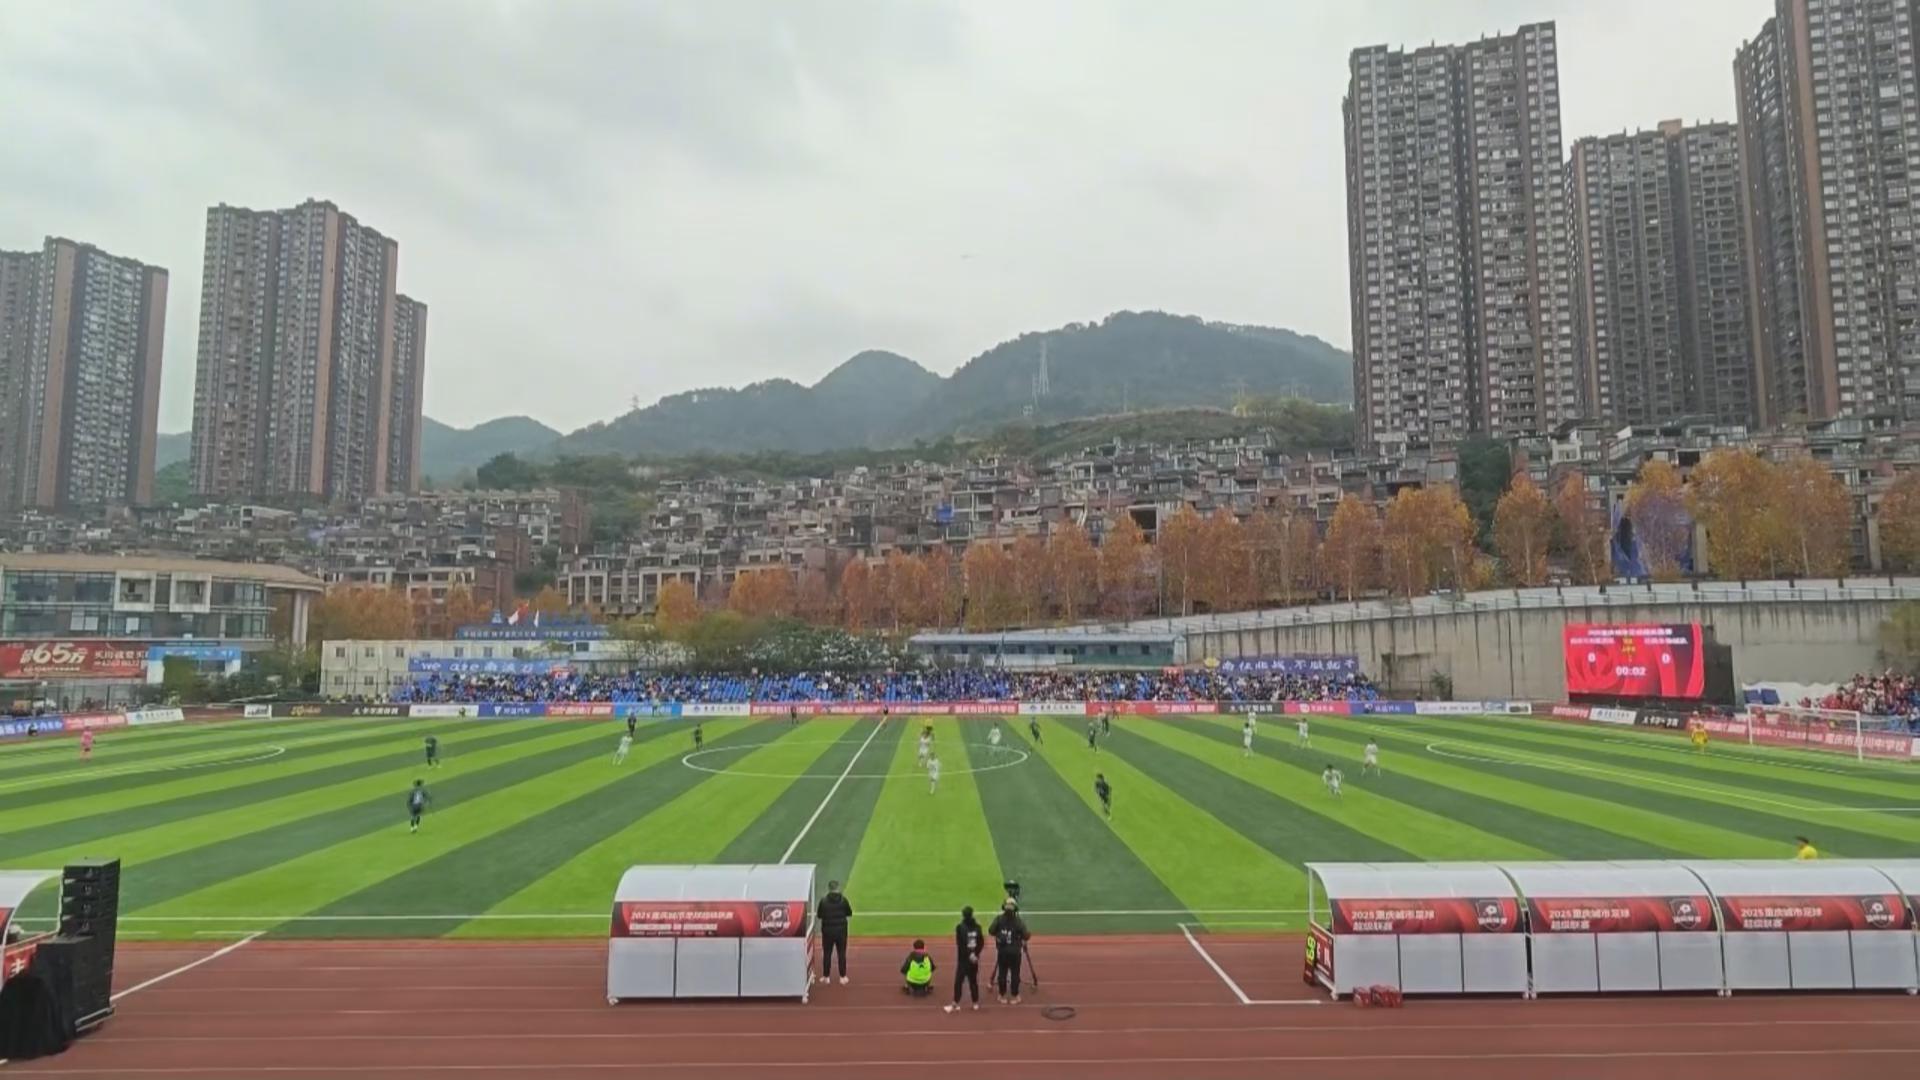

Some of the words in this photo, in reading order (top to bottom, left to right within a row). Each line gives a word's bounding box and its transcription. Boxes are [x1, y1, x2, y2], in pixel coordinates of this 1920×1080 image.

[1588, 653, 1596, 662] 0
[1662, 653, 1671, 663] 0
[1616, 666, 1646, 676] 00:02
